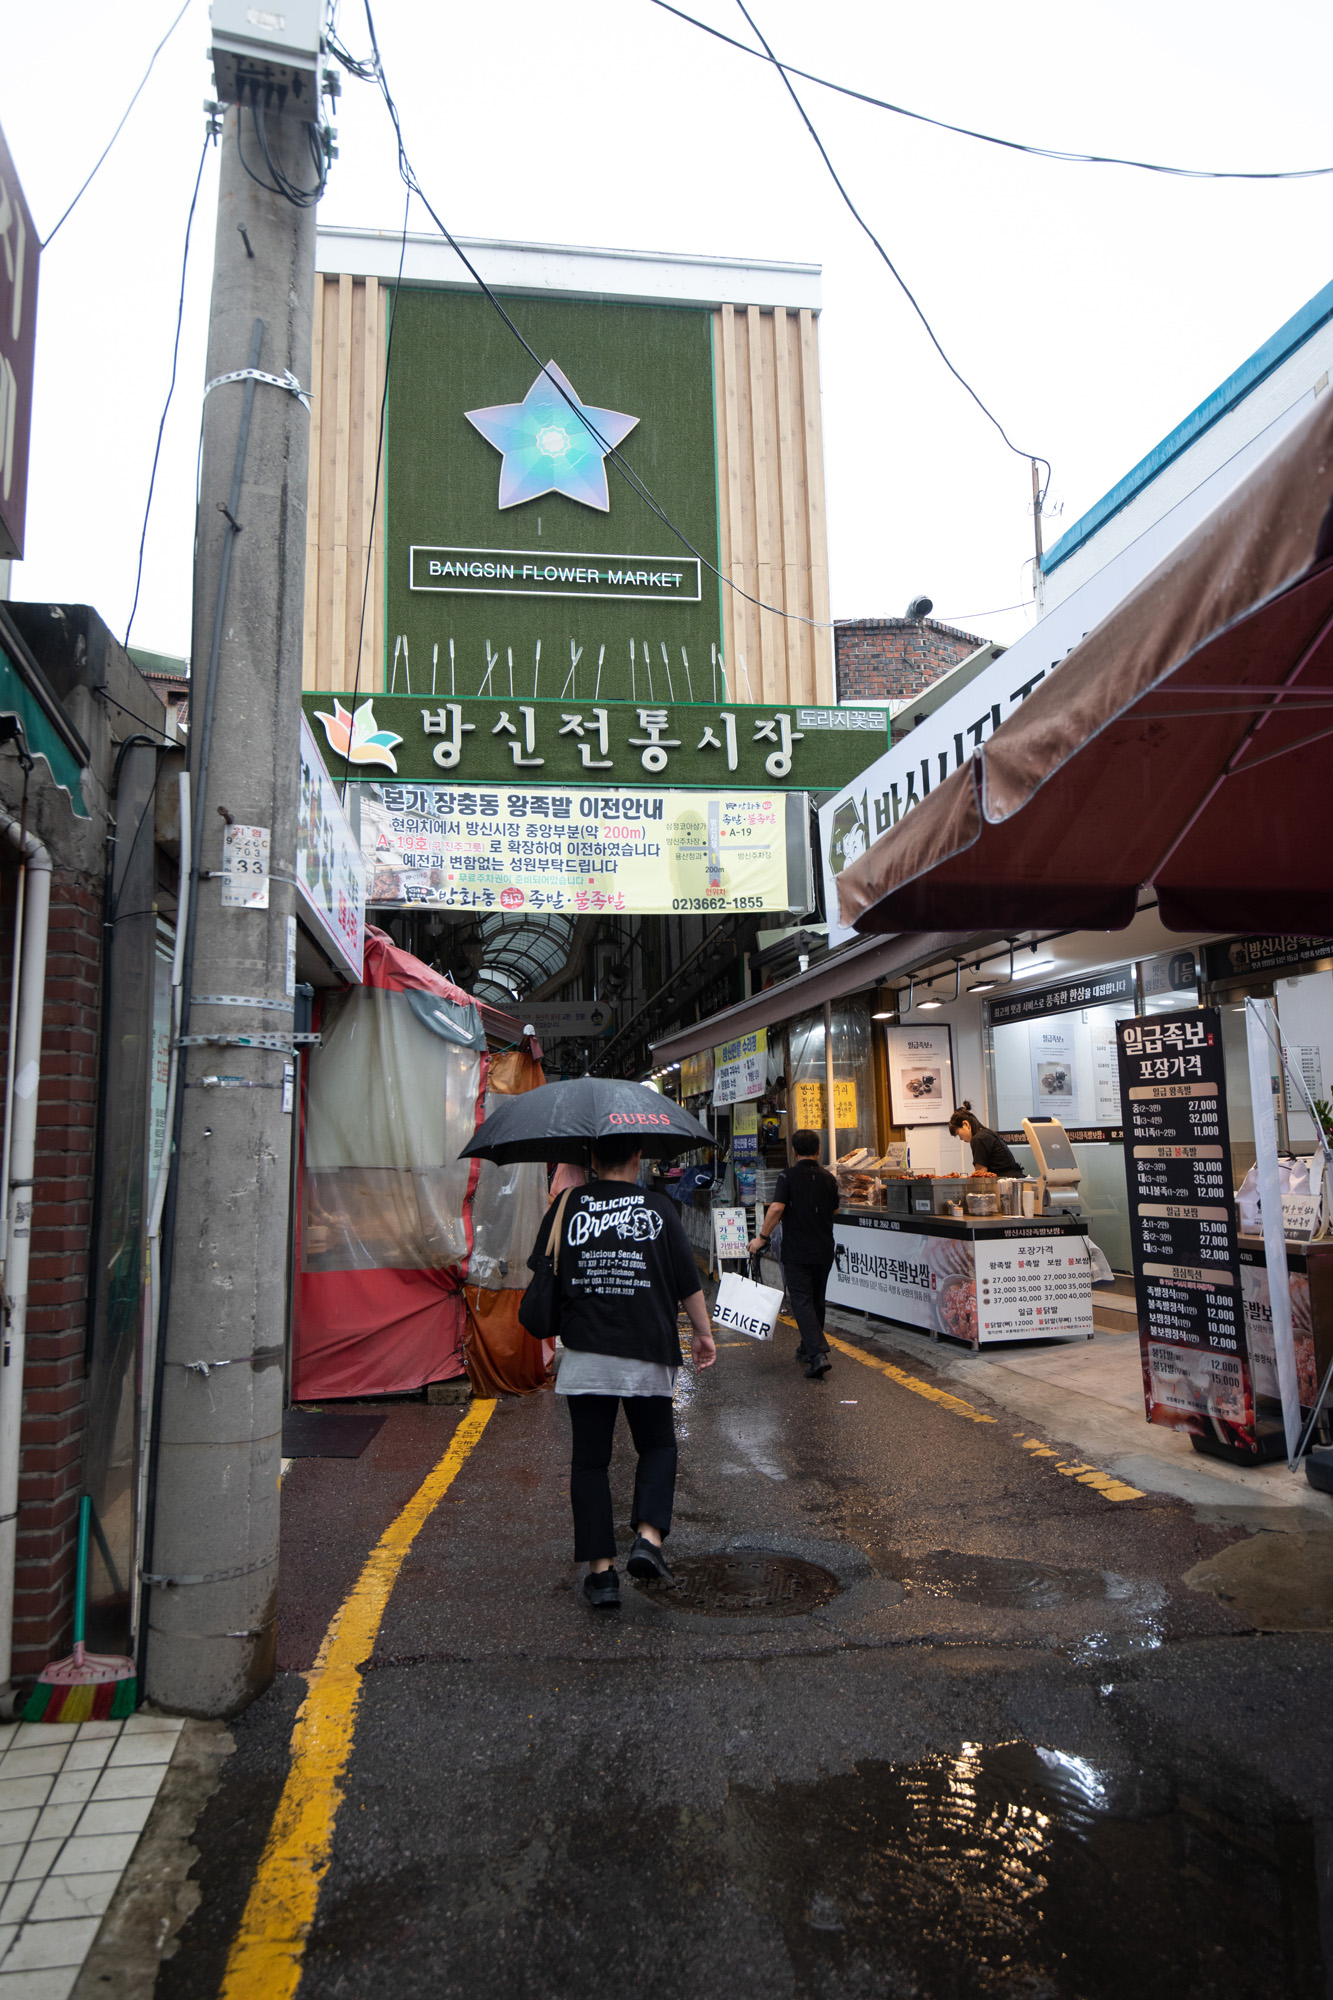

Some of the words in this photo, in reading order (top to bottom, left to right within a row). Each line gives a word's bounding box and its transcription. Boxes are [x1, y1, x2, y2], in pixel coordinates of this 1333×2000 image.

[429, 560, 515, 581] BANGSIN
[522, 564, 601, 583] FLOWER
[608, 567, 684, 588] MARKET
[802, 710, 887, 730] 도라지꽃문
[421, 703, 805, 778] 방신전통시장
[384, 789, 430, 813] 본가
[434, 791, 500, 817] 장충동
[507, 794, 573, 819] 왕족발
[579, 797, 664, 821] 이전안내
[391, 817, 461, 836] 현위치에서
[466, 820, 521, 840] 방신시장
[603, 825, 647, 843] 200m)
[729, 828, 753, 838] A-19
[489, 840, 504, 854] 로
[507, 840, 563, 857] 확장하여
[567, 843, 661, 859] 이전하였습니다
[402, 852, 445, 870] 예전과
[449, 855, 506, 872] 변함없는
[509, 858, 618, 875] 성원부탁드립니다
[705, 866, 726, 874] 200m
[459, 872, 512, 885] 무료주차권이
[439, 886, 497, 908] 방화동
[705, 888, 727, 897] 현위치
[672, 896, 764, 911] 02)3662-1855
[1023, 999, 1045, 1012] 서비스로
[1046, 991, 1068, 1007] 풍족한
[1070, 985, 1092, 1003] 한상을
[1093, 980, 1127, 998] 대접합니다
[1123, 1021, 1208, 1056] 일급족보
[907, 1041, 931, 1050] 일급족보
[1139, 1055, 1203, 1079] 포장가격
[1153, 1087, 1167, 1098] 일급
[1169, 1085, 1193, 1097] 왕족발
[1188, 1100, 1217, 1111] 27,000
[609, 1113, 671, 1125] GUESS
[1189, 1113, 1218, 1124] 32,000
[1194, 1126, 1219, 1137] 11,000
[1158, 1147, 1172, 1157] 일급
[1174, 1147, 1198, 1157] 불족발
[1193, 1162, 1222, 1173] 30,000
[1194, 1174, 1223, 1186] 35,000
[1197, 1187, 1224, 1199] 12,000
[580, 1195, 595, 1204] The
[588, 1195, 645, 1212] DELICIOUS
[1166, 1206, 1181, 1217] 일급
[1183, 1208, 1199, 1219] 보쌈
[567, 1206, 632, 1246] Bread
[1200, 1222, 1228, 1234] 15,000
[720, 1234, 745, 1242] 우산
[1004, 1228, 1061, 1238] 방신시장족발보쌈
[1200, 1235, 1228, 1247] 27,000
[581, 1250, 616, 1260] Delicious
[617, 1250, 644, 1261] Sendai
[1018, 1246, 1054, 1256] 포장가격
[1201, 1249, 1230, 1261] 32,000
[629, 1261, 647, 1270] SEOUL
[849, 1250, 930, 1289] 방신시장족발보쌈
[989, 1261, 1012, 1270] 왕족발
[1017, 1259, 1040, 1269] 불족발
[1047, 1258, 1062, 1267] 보쌈
[1067, 1257, 1090, 1266] 불보쌈
[992, 1276, 1017, 1285] 27,000
[1017, 1274, 1041, 1283] 30,000
[1043, 1273, 1067, 1282] 27,000
[1067, 1271, 1091, 1281] 30,000
[1172, 1267, 1202, 1280] 점심특선
[592, 1278, 602, 1286] USA
[993, 1286, 1017, 1295] 32,000
[1018, 1285, 1042, 1293] 35,000
[1044, 1283, 1068, 1292] 32,000
[1068, 1281, 1091, 1290] 35,000
[993, 1296, 1017, 1305] 37,000
[1018, 1295, 1042, 1304] 40,000
[1045, 1293, 1068, 1302] 37,000
[1068, 1291, 1092, 1300] 40,000
[1205, 1293, 1234, 1307] 10,000
[1018, 1307, 1034, 1317] 일급
[1036, 1306, 1058, 1316] 불닭발
[1206, 1307, 1235, 1322] 12,000
[711, 1303, 772, 1338] BEAKER
[1014, 1319, 1034, 1328] 12000
[1074, 1315, 1093, 1323] 15000
[1207, 1321, 1237, 1336] 10,000
[1209, 1335, 1238, 1350] 12,000
[1211, 1359, 1239, 1374] 12,000
[1211, 1373, 1241, 1388] 15,000
